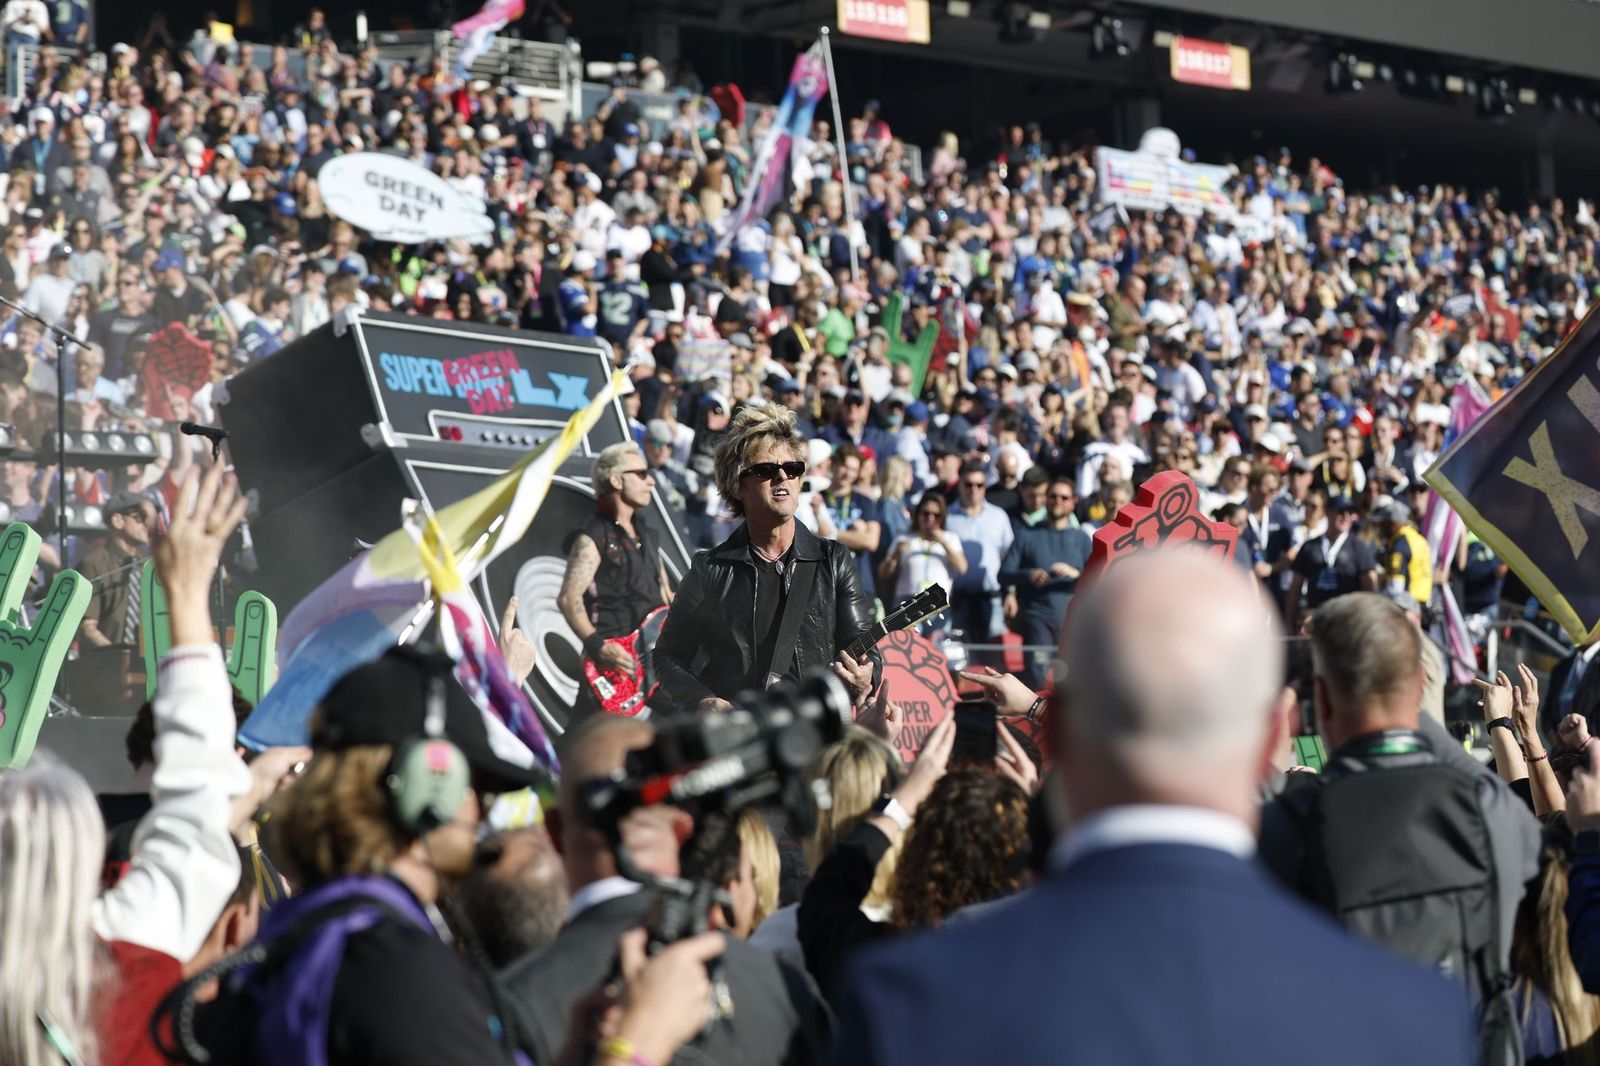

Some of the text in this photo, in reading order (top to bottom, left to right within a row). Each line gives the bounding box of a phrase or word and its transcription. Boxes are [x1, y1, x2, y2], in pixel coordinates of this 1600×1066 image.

[364, 170, 444, 210] GREEN
[380, 195, 427, 223] DAY
[600, 291, 633, 326] 12
[379, 352, 452, 397] SUPER
[442, 347, 520, 388] GREEN
[466, 381, 514, 415] DAY
